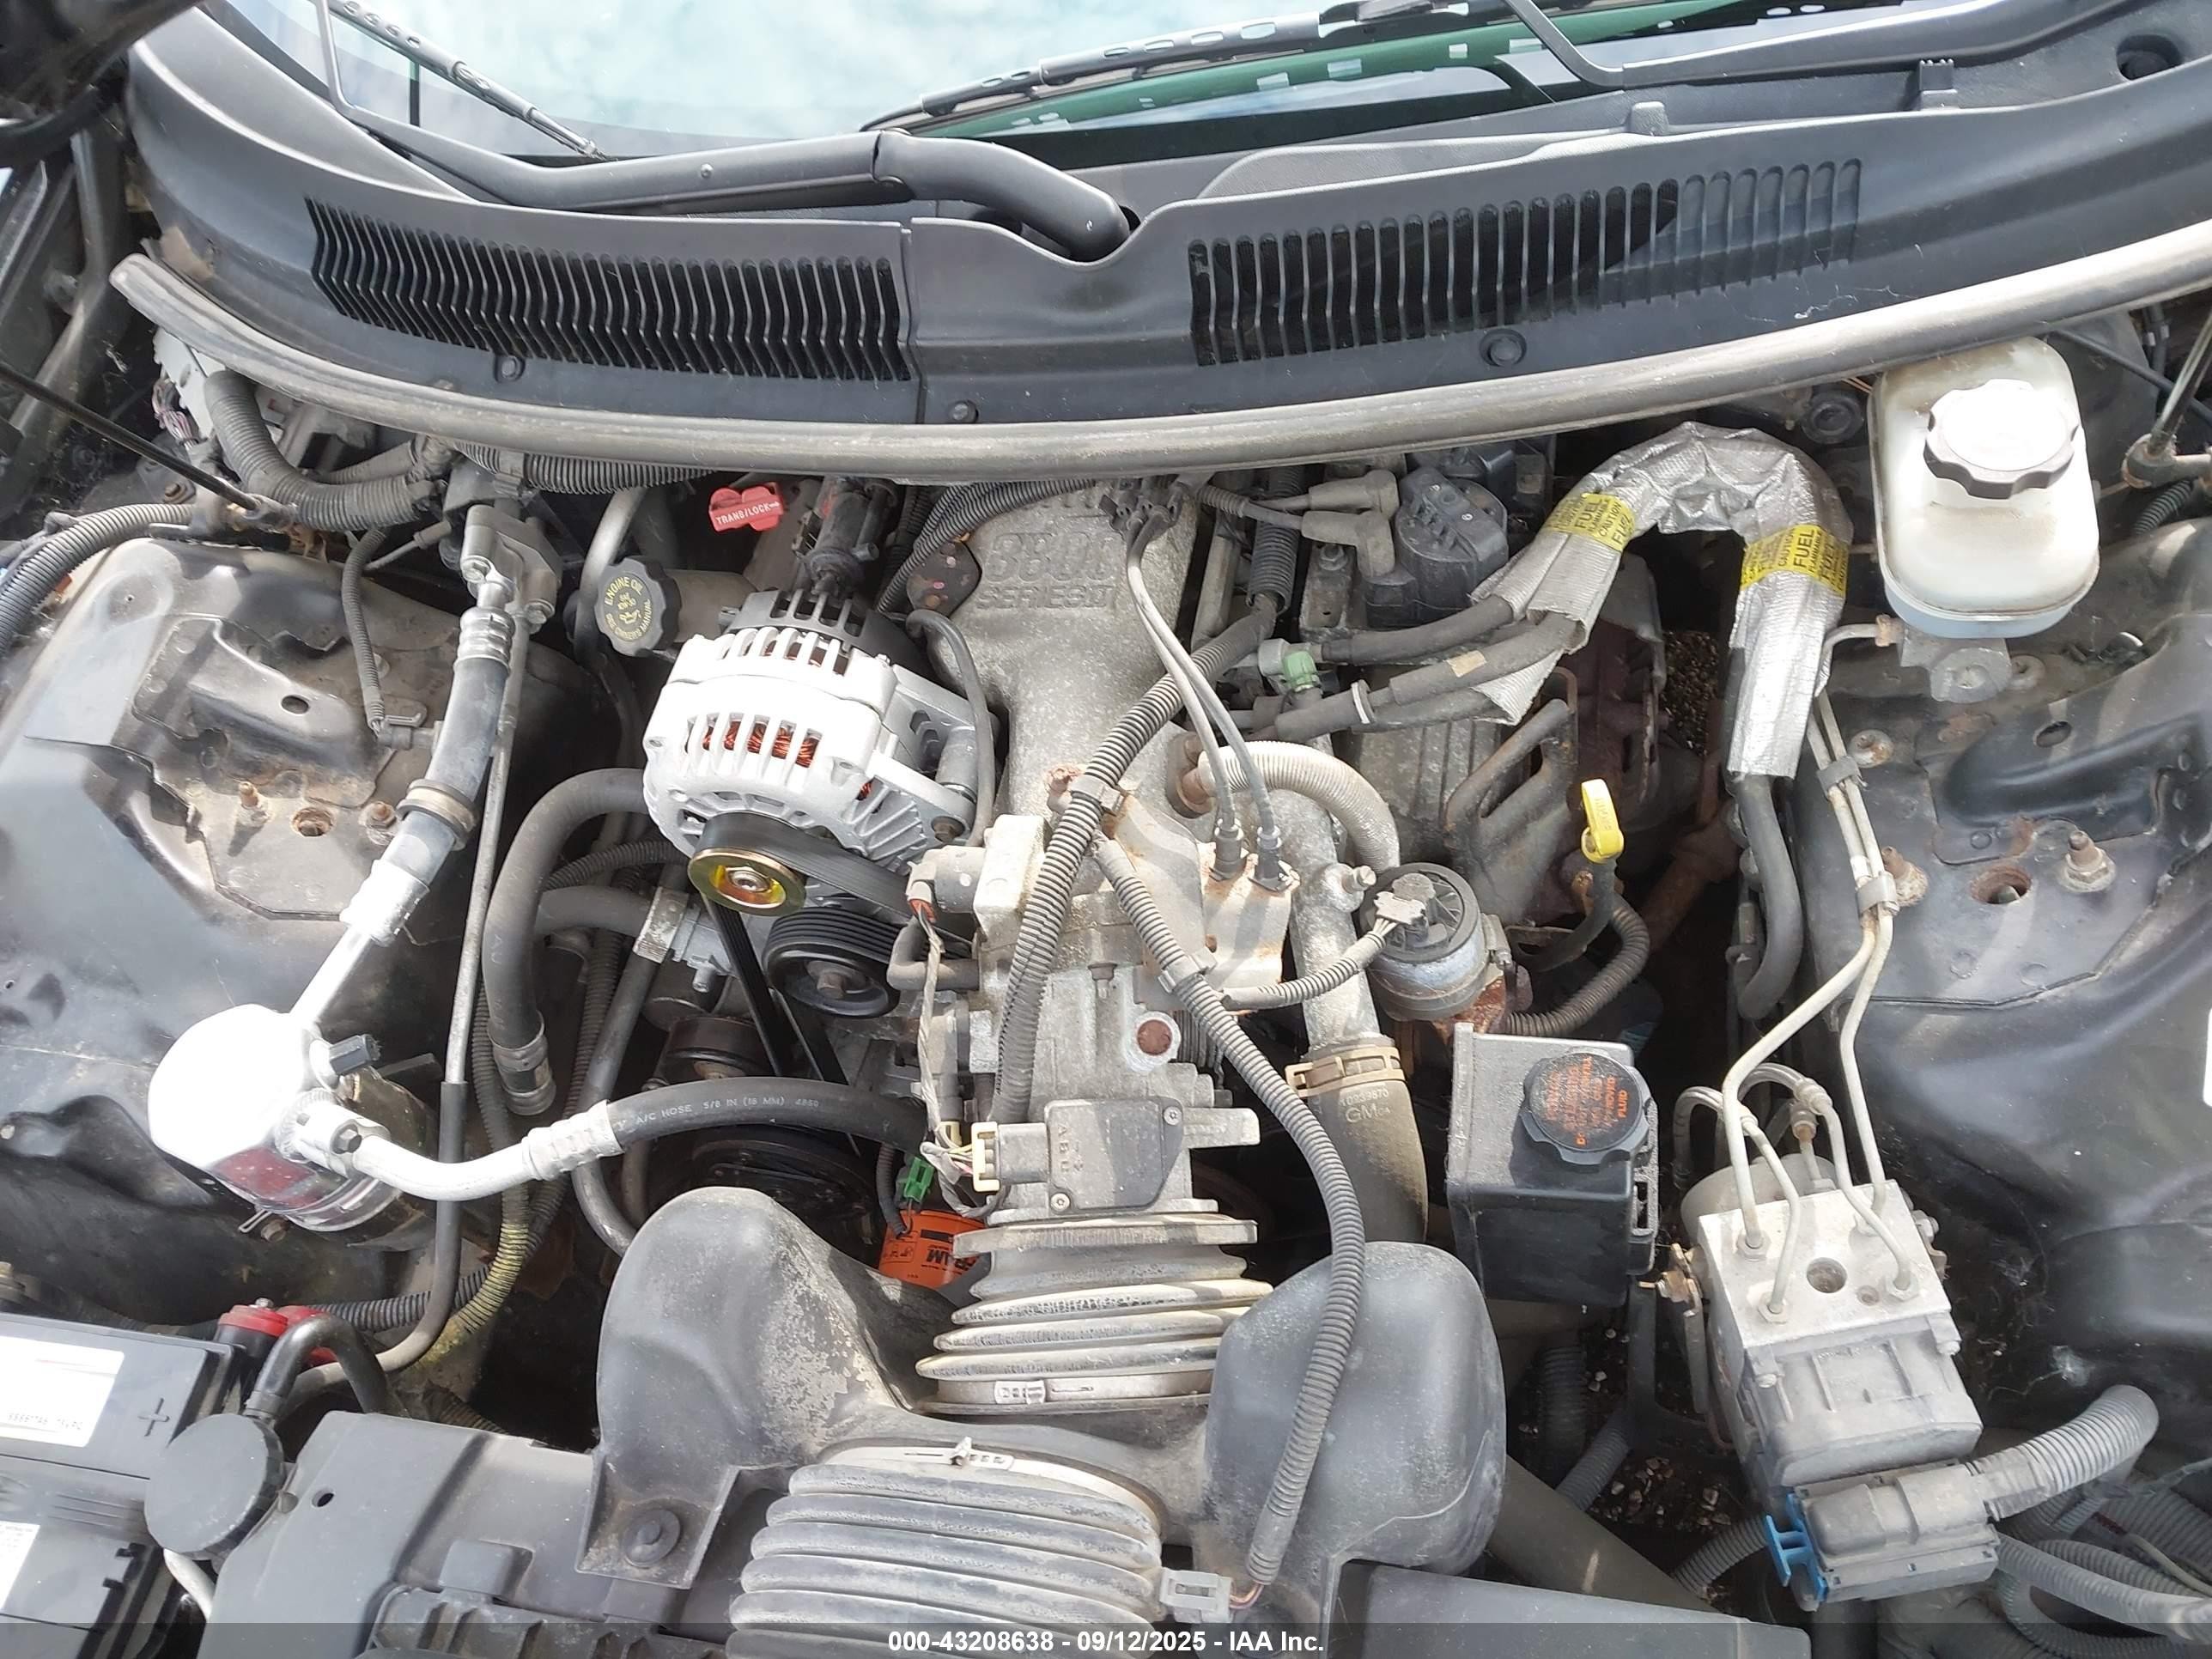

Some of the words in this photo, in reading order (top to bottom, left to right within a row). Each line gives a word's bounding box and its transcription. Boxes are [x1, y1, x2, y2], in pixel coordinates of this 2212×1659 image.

[1574, 499, 1602, 529] FUEL
[1598, 501, 1621, 537] CAUTION
[1793, 530, 1814, 568] FUEL
[604, 576, 631, 606] ENGINE
[661, 1104, 693, 1118] HOSE
[1617, 1089, 1627, 1118] FLUID
